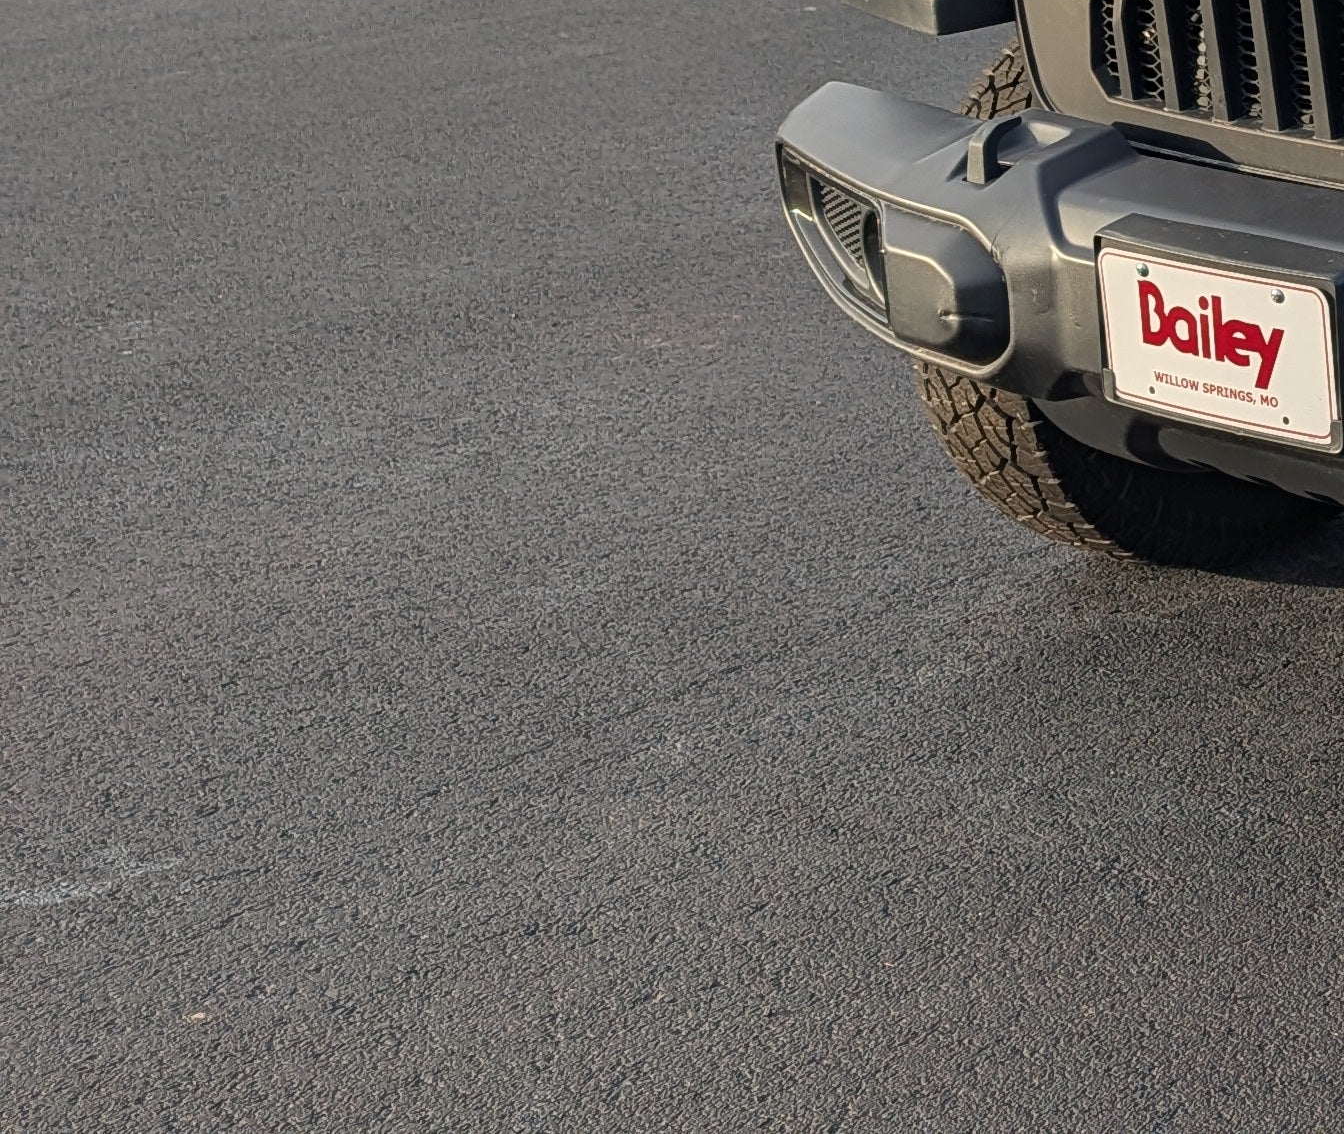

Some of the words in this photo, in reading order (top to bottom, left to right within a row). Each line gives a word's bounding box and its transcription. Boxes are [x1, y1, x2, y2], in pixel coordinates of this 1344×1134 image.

[1137, 279, 1285, 390] Bailey
[1154, 370, 1199, 392] WILLOW
[1202, 382, 1257, 406] SPRINGS,
[1260, 393, 1279, 408] MO
